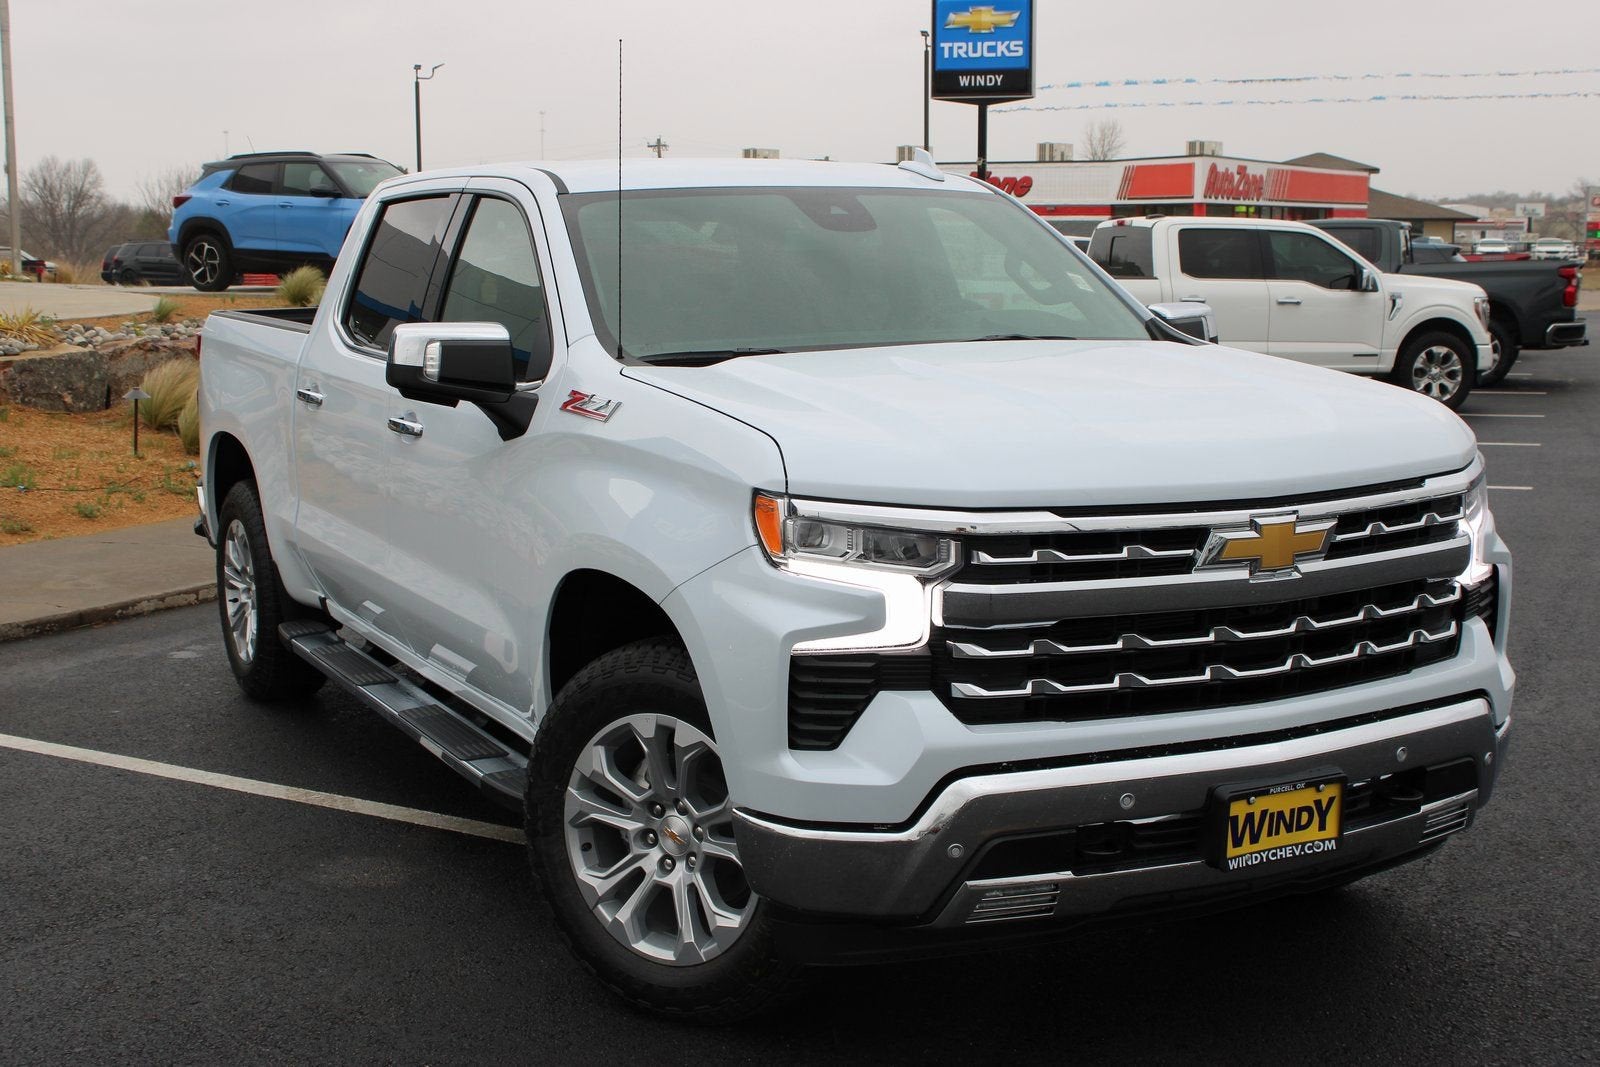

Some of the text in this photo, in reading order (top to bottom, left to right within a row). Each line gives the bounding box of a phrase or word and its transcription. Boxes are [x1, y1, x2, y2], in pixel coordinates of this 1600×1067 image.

[940, 40, 1024, 59] TRUCKS
[959, 74, 1003, 87] WINDY
[1203, 162, 1264, 202] AutoZone
[1229, 796, 1336, 849] WINDY
[1228, 839, 1337, 871] WINDYCHEV.COM
